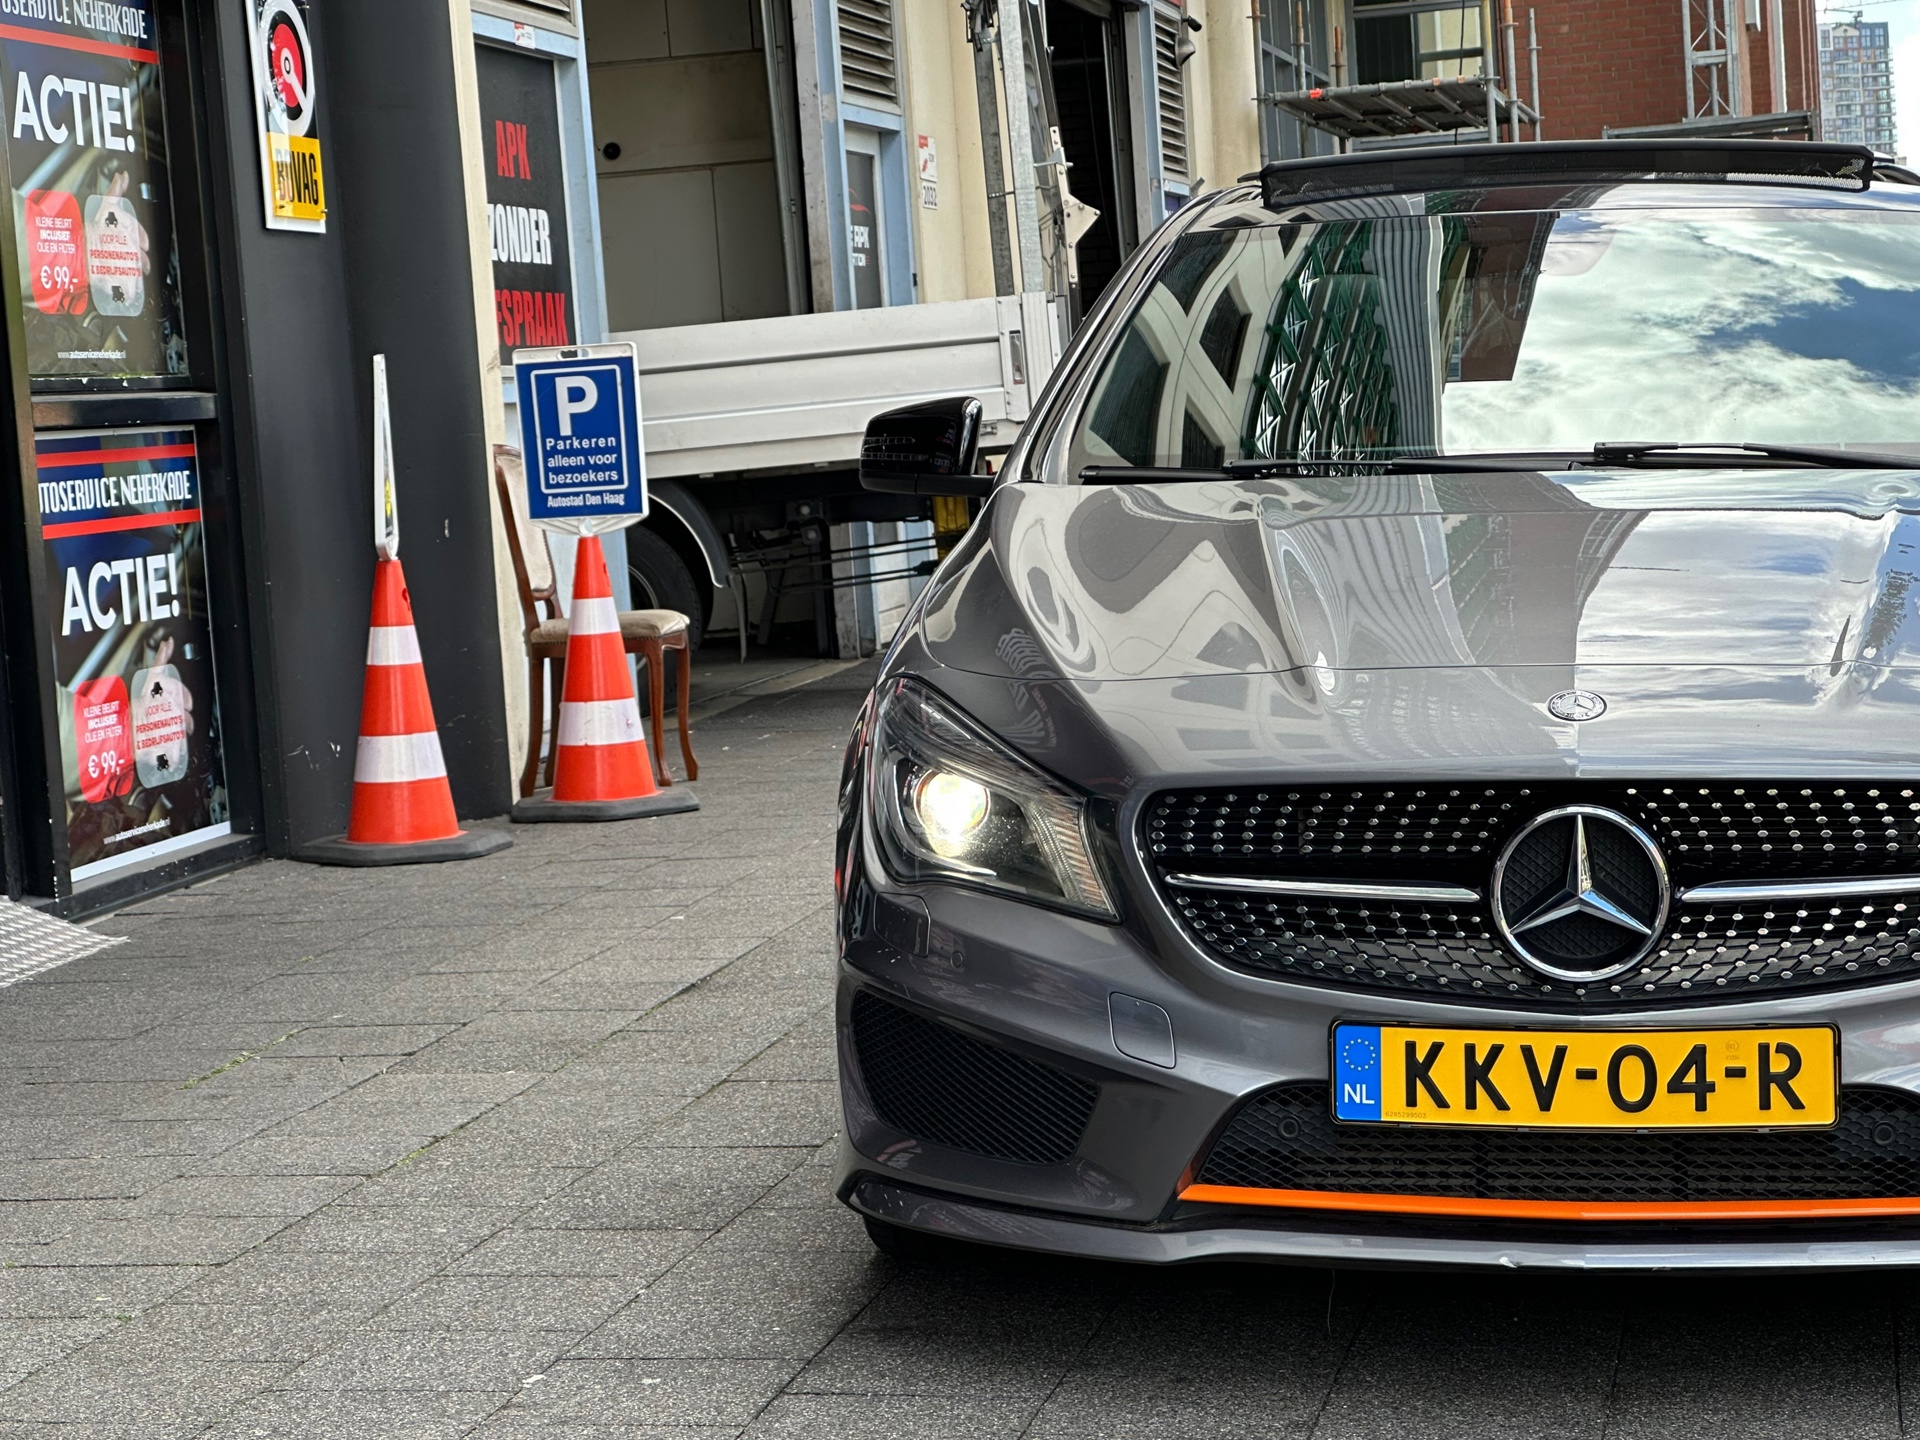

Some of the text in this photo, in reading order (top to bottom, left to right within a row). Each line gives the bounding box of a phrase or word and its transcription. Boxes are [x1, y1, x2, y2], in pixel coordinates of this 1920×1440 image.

[73, 0, 148, 39] NEHERKADE
[13, 71, 135, 153] ACTIE!
[495, 120, 531, 180] APK
[35, 216, 72, 229] KLEINE BEURT
[40, 230, 71, 241] INCLUSIEF
[487, 203, 552, 265] ZONDER
[89, 248, 139, 261] PERSONENAUTO'S
[40, 265, 78, 293] € 99,-
[555, 375, 598, 437] P
[546, 436, 616, 450] Parkeren
[547, 453, 617, 467] alleen voor
[549, 470, 618, 484] bezoekers
[120, 470, 192, 506] NEHERKADE
[547, 492, 625, 508] Autostad Den Haag
[62, 553, 180, 636] ACTIE!
[83, 700, 120, 718] KLEINE BEURT
[87, 713, 118, 730] INCLUSIEF
[135, 715, 183, 734] PERSONENAUTO'S
[88, 750, 125, 778] € 99,-
[1404, 1040, 1806, 1114] KKV-04-R
[1344, 1083, 1375, 1104] NL
